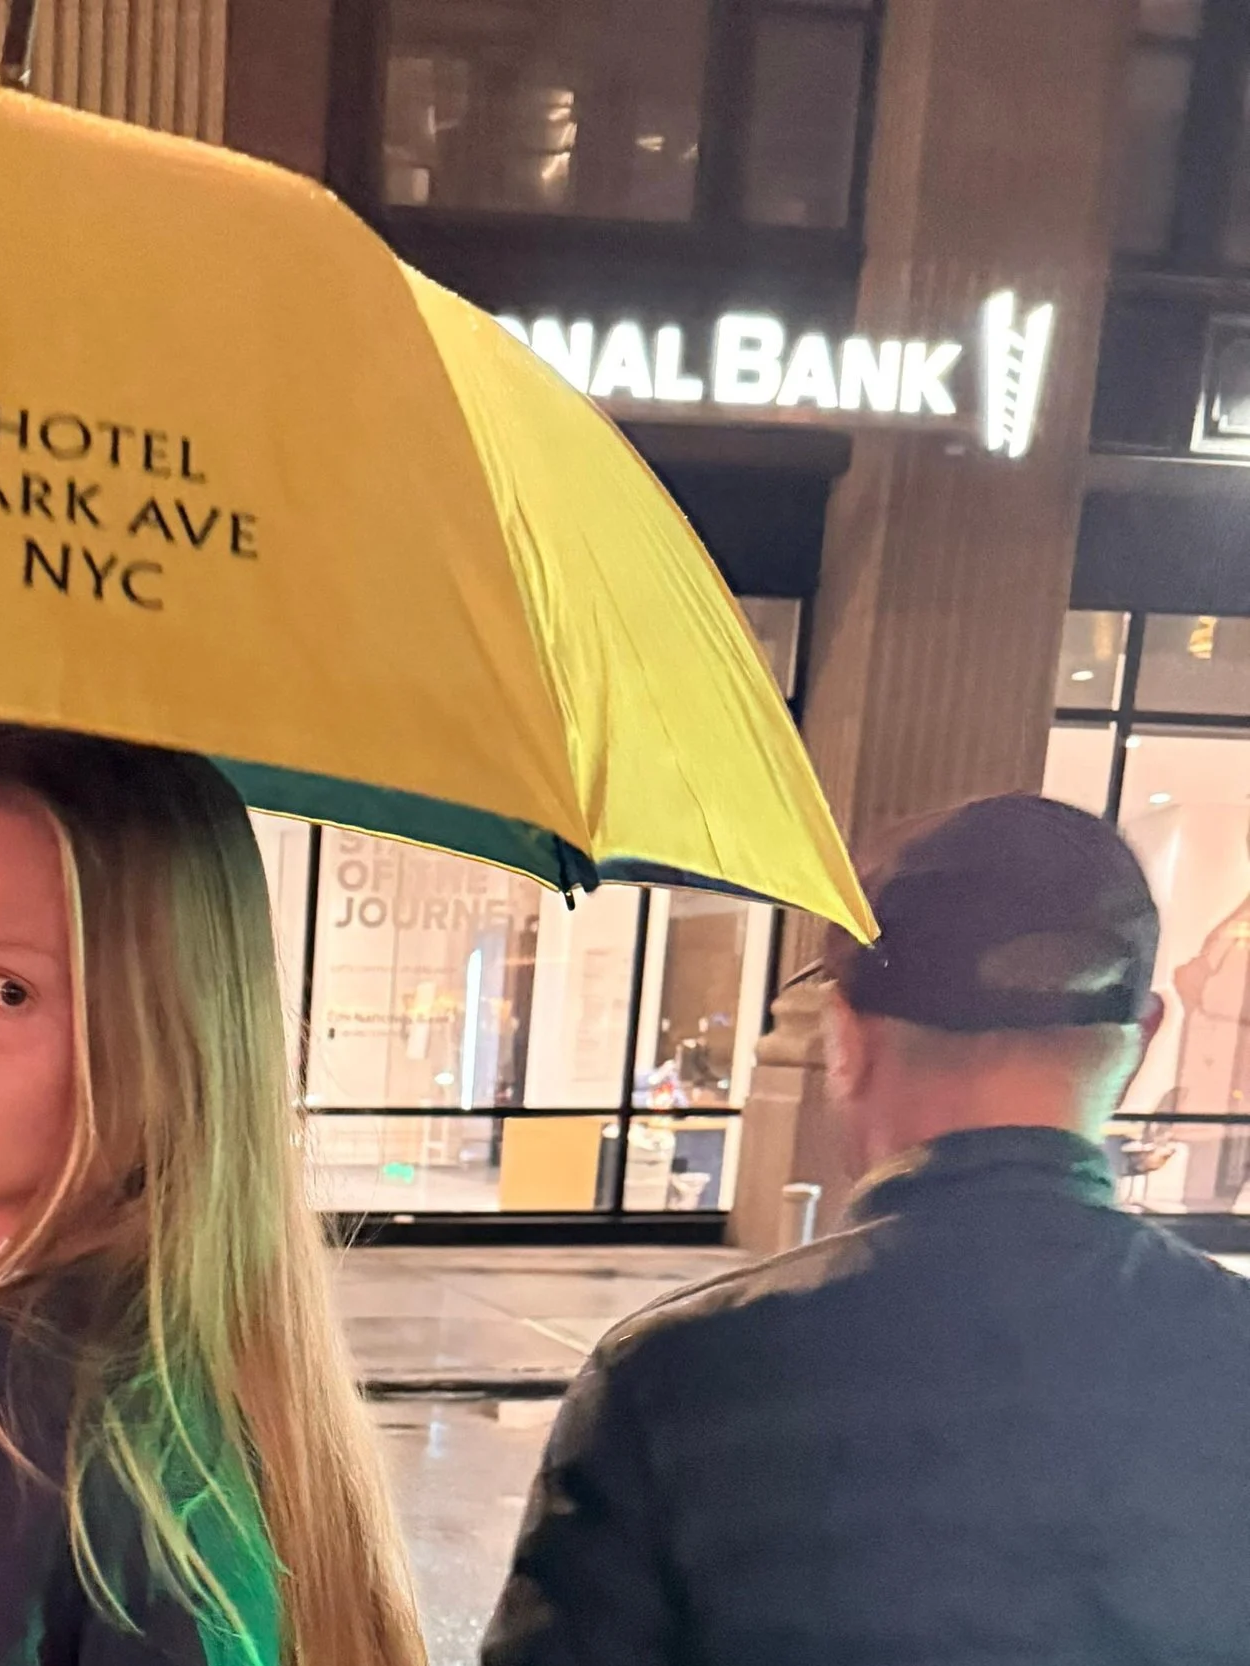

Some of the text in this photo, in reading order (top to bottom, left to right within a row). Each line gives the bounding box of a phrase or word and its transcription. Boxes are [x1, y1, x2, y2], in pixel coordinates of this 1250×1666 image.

[128, 496, 259, 560] AVE
[24, 535, 164, 611] NYC
[337, 859, 395, 892] OF
